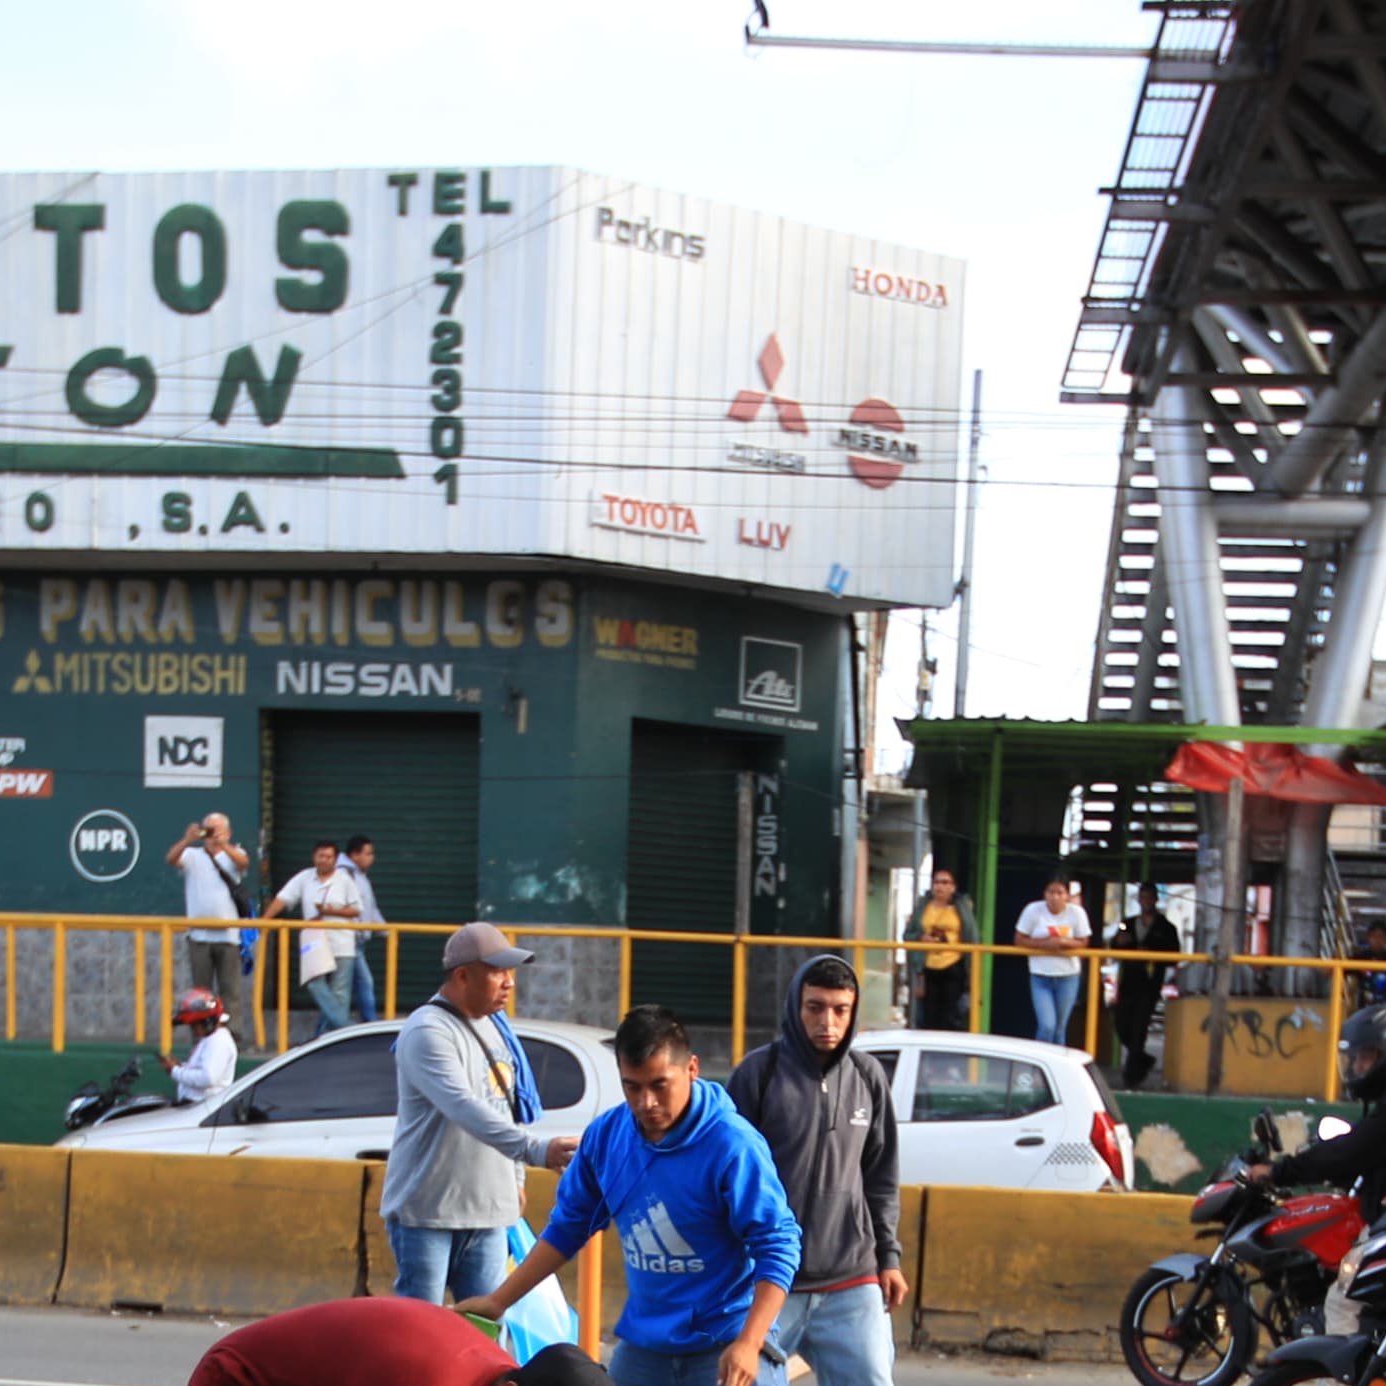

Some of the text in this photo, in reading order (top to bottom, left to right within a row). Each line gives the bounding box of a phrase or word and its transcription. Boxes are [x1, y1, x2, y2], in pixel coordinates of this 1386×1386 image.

[388, 171, 512, 216] TEL
[849, 266, 949, 309] HONDA
[429, 222, 465, 506] 472301
[838, 427, 920, 464] NISSAN
[602, 495, 701, 537] TOYOTA
[738, 518, 792, 551] LUV
[38, 576, 197, 646] PARA
[212, 577, 576, 649] VEHICULOS
[594, 616, 700, 656] WAGNER
[54, 652, 248, 697] MITSUBISHI
[275, 660, 454, 697] NISSAN
[79, 828, 129, 852] NPR
[755, 772, 779, 898] NISSAN
